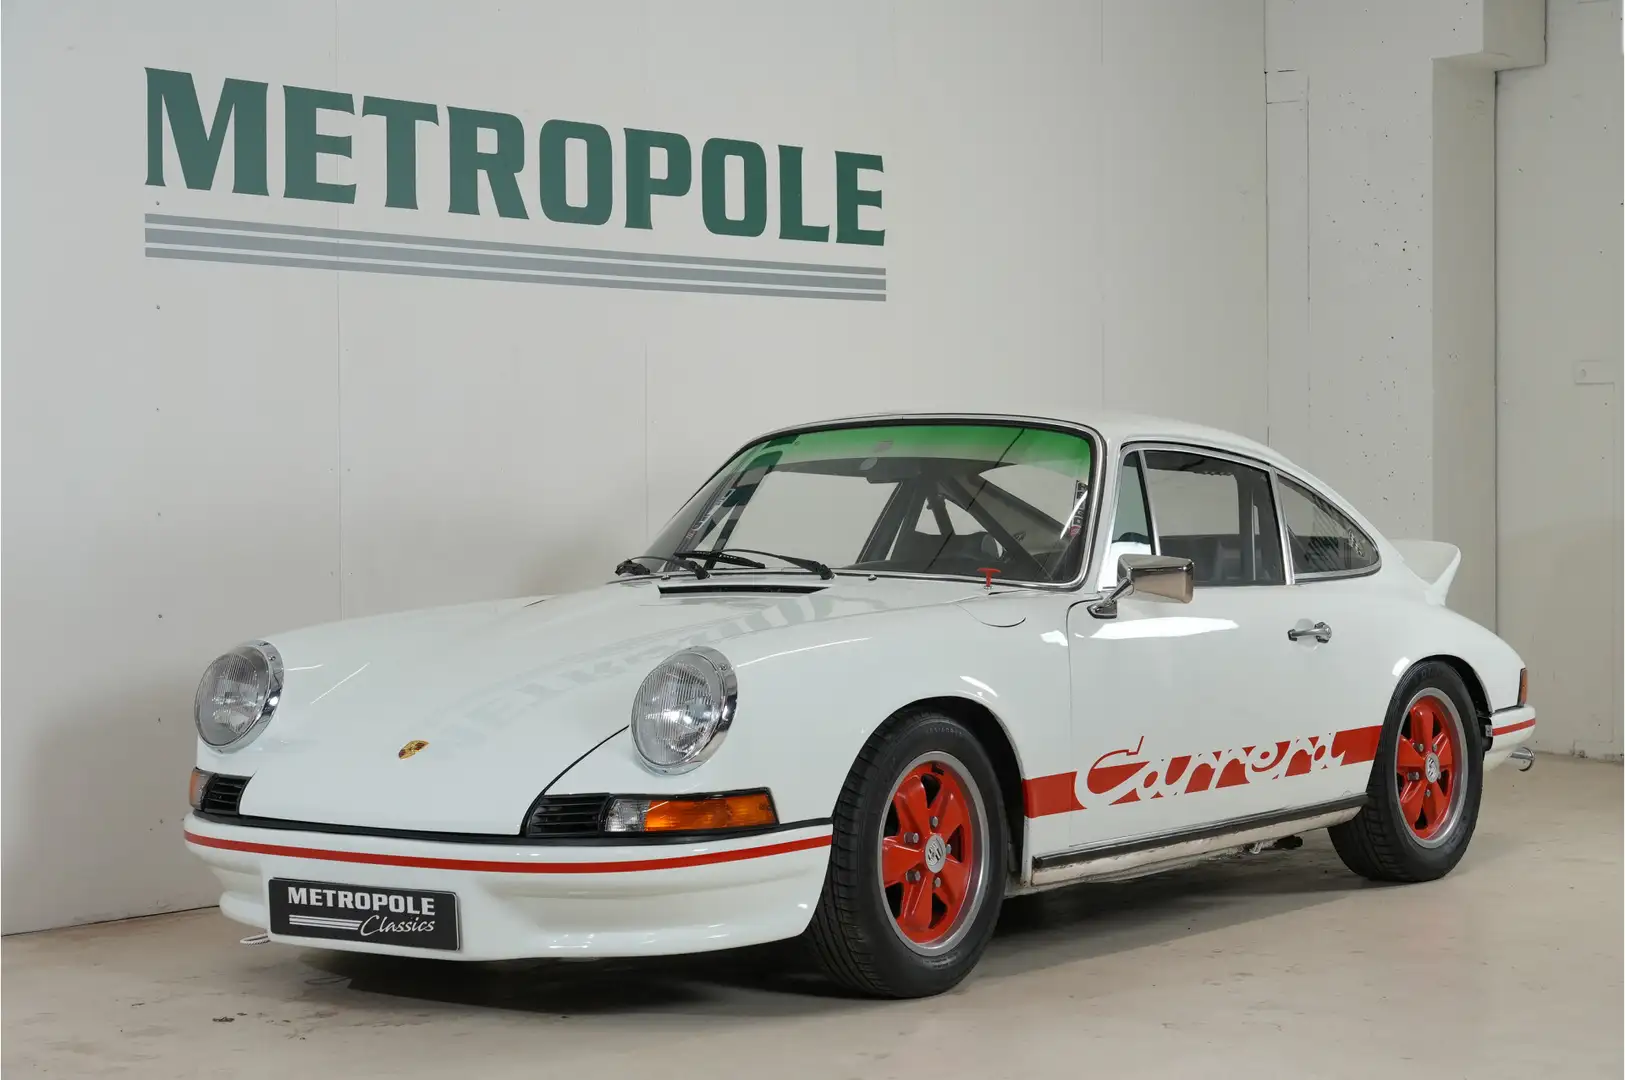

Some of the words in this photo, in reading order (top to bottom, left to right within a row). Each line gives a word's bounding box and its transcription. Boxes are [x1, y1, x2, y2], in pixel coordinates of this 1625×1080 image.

[144, 67, 886, 246] METROPOLE
[1074, 733, 1345, 809] Carrera
[287, 886, 436, 916] METROPOLE
[360, 914, 436, 937] Classics
